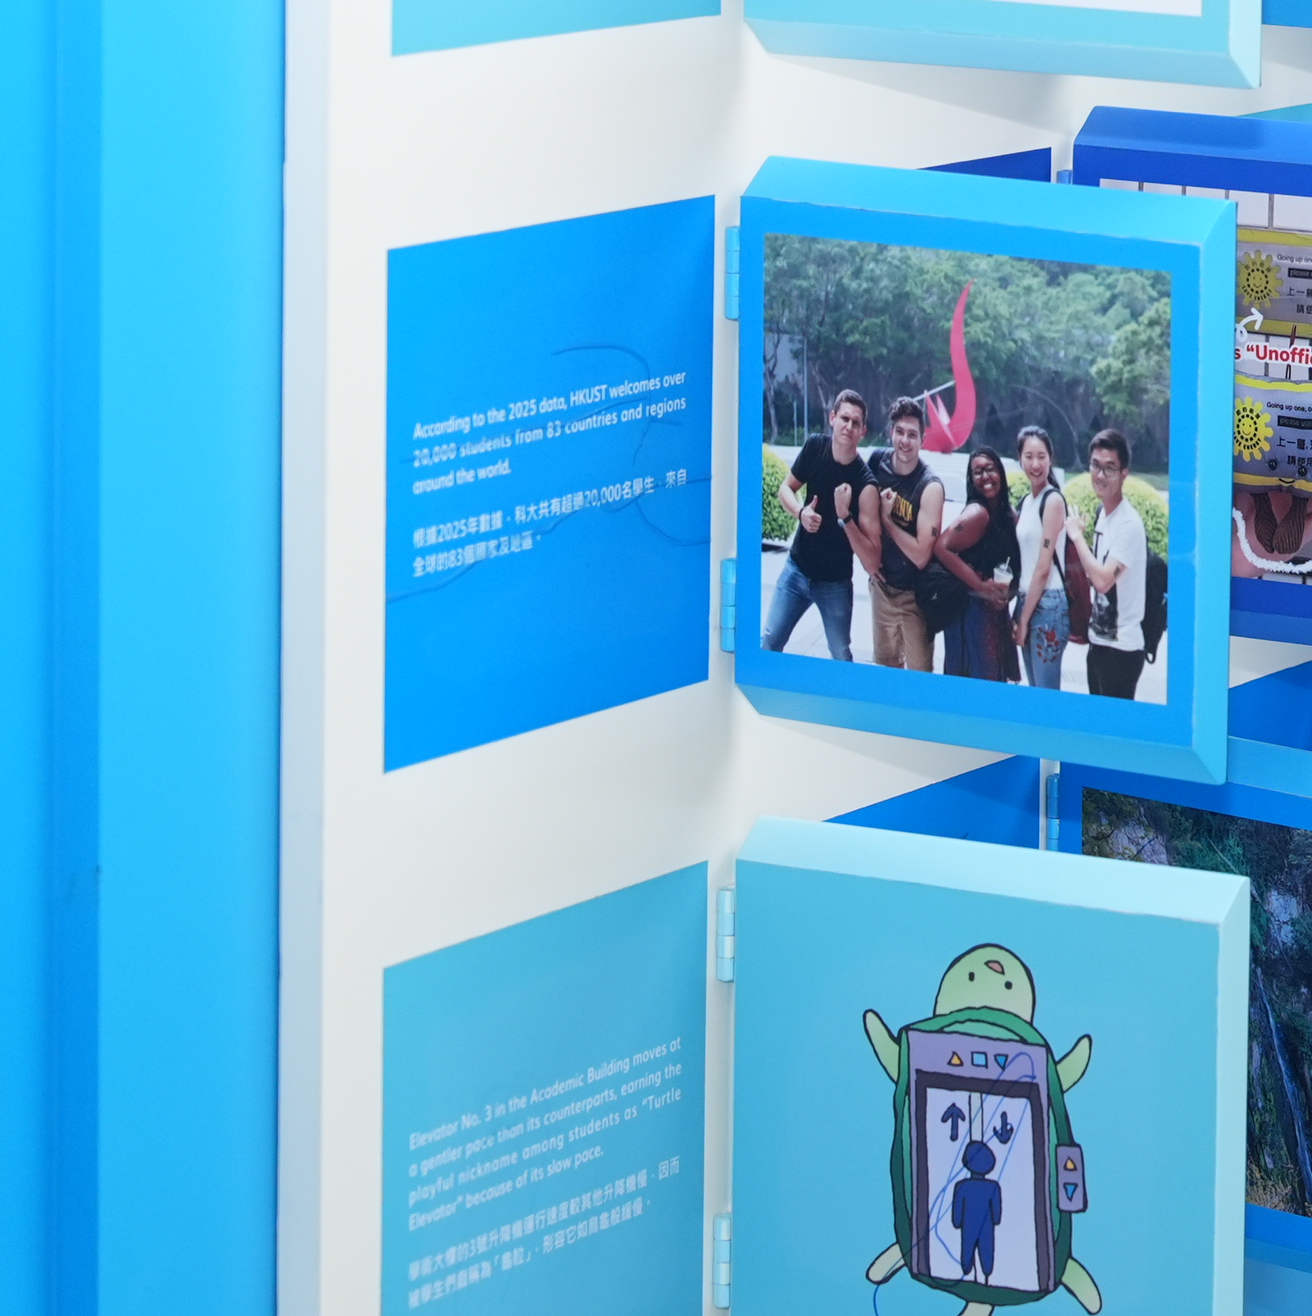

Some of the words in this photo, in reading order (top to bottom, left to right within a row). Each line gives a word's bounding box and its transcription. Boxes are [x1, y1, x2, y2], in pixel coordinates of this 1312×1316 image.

[413, 416, 471, 439] According
[472, 413, 486, 427] to
[487, 408, 506, 424] the
[509, 399, 537, 420] 2025
[539, 397, 568, 413] data,
[570, 384, 607, 406] HKUST
[609, 378, 661, 398] welcomes
[663, 372, 686, 387] over
[414, 443, 457, 467] 20,000
[460, 436, 512, 457] students
[515, 429, 544, 444] from
[546, 420, 562, 438] 83
[565, 412, 618, 434] countries
[621, 404, 642, 422] and
[646, 398, 686, 418] regions
[1266, 401, 1285, 412] Going
[413, 471, 455, 494] around
[456, 469, 476, 484] the
[477, 459, 511, 479] world.
[409, 1164, 418, 1177] a
[421, 1146, 463, 1176] gentler
[465, 1137, 494, 1158] pace
[498, 1123, 524, 1143] than
[527, 1117, 541, 1131] its
[544, 1089, 617, 1125] counterparts,
[621, 1071, 661, 1096] earning
[664, 1064, 681, 1079] the
[410, 1121, 458, 1150] Elevator
[461, 1114, 481, 1129] No.
[485, 1105, 492, 1121] 3
[495, 1104, 506, 1117] in
[508, 1096, 527, 1112] the
[530, 1075, 584, 1104] Academic
[588, 1058, 630, 1083] Building
[633, 1044, 667, 1065] moves
[670, 1037, 681, 1052] at
[409, 1173, 455, 1207] playful
[458, 1152, 518, 1184] nickname
[522, 1134, 564, 1159] among
[568, 1113, 620, 1142] students
[624, 1106, 638, 1120] as
[465, 1180, 513, 1208] because
[515, 1170, 528, 1188] of
[531, 1168, 544, 1182] its
[547, 1158, 572, 1176] slow
[575, 1146, 603, 1168] pace.
